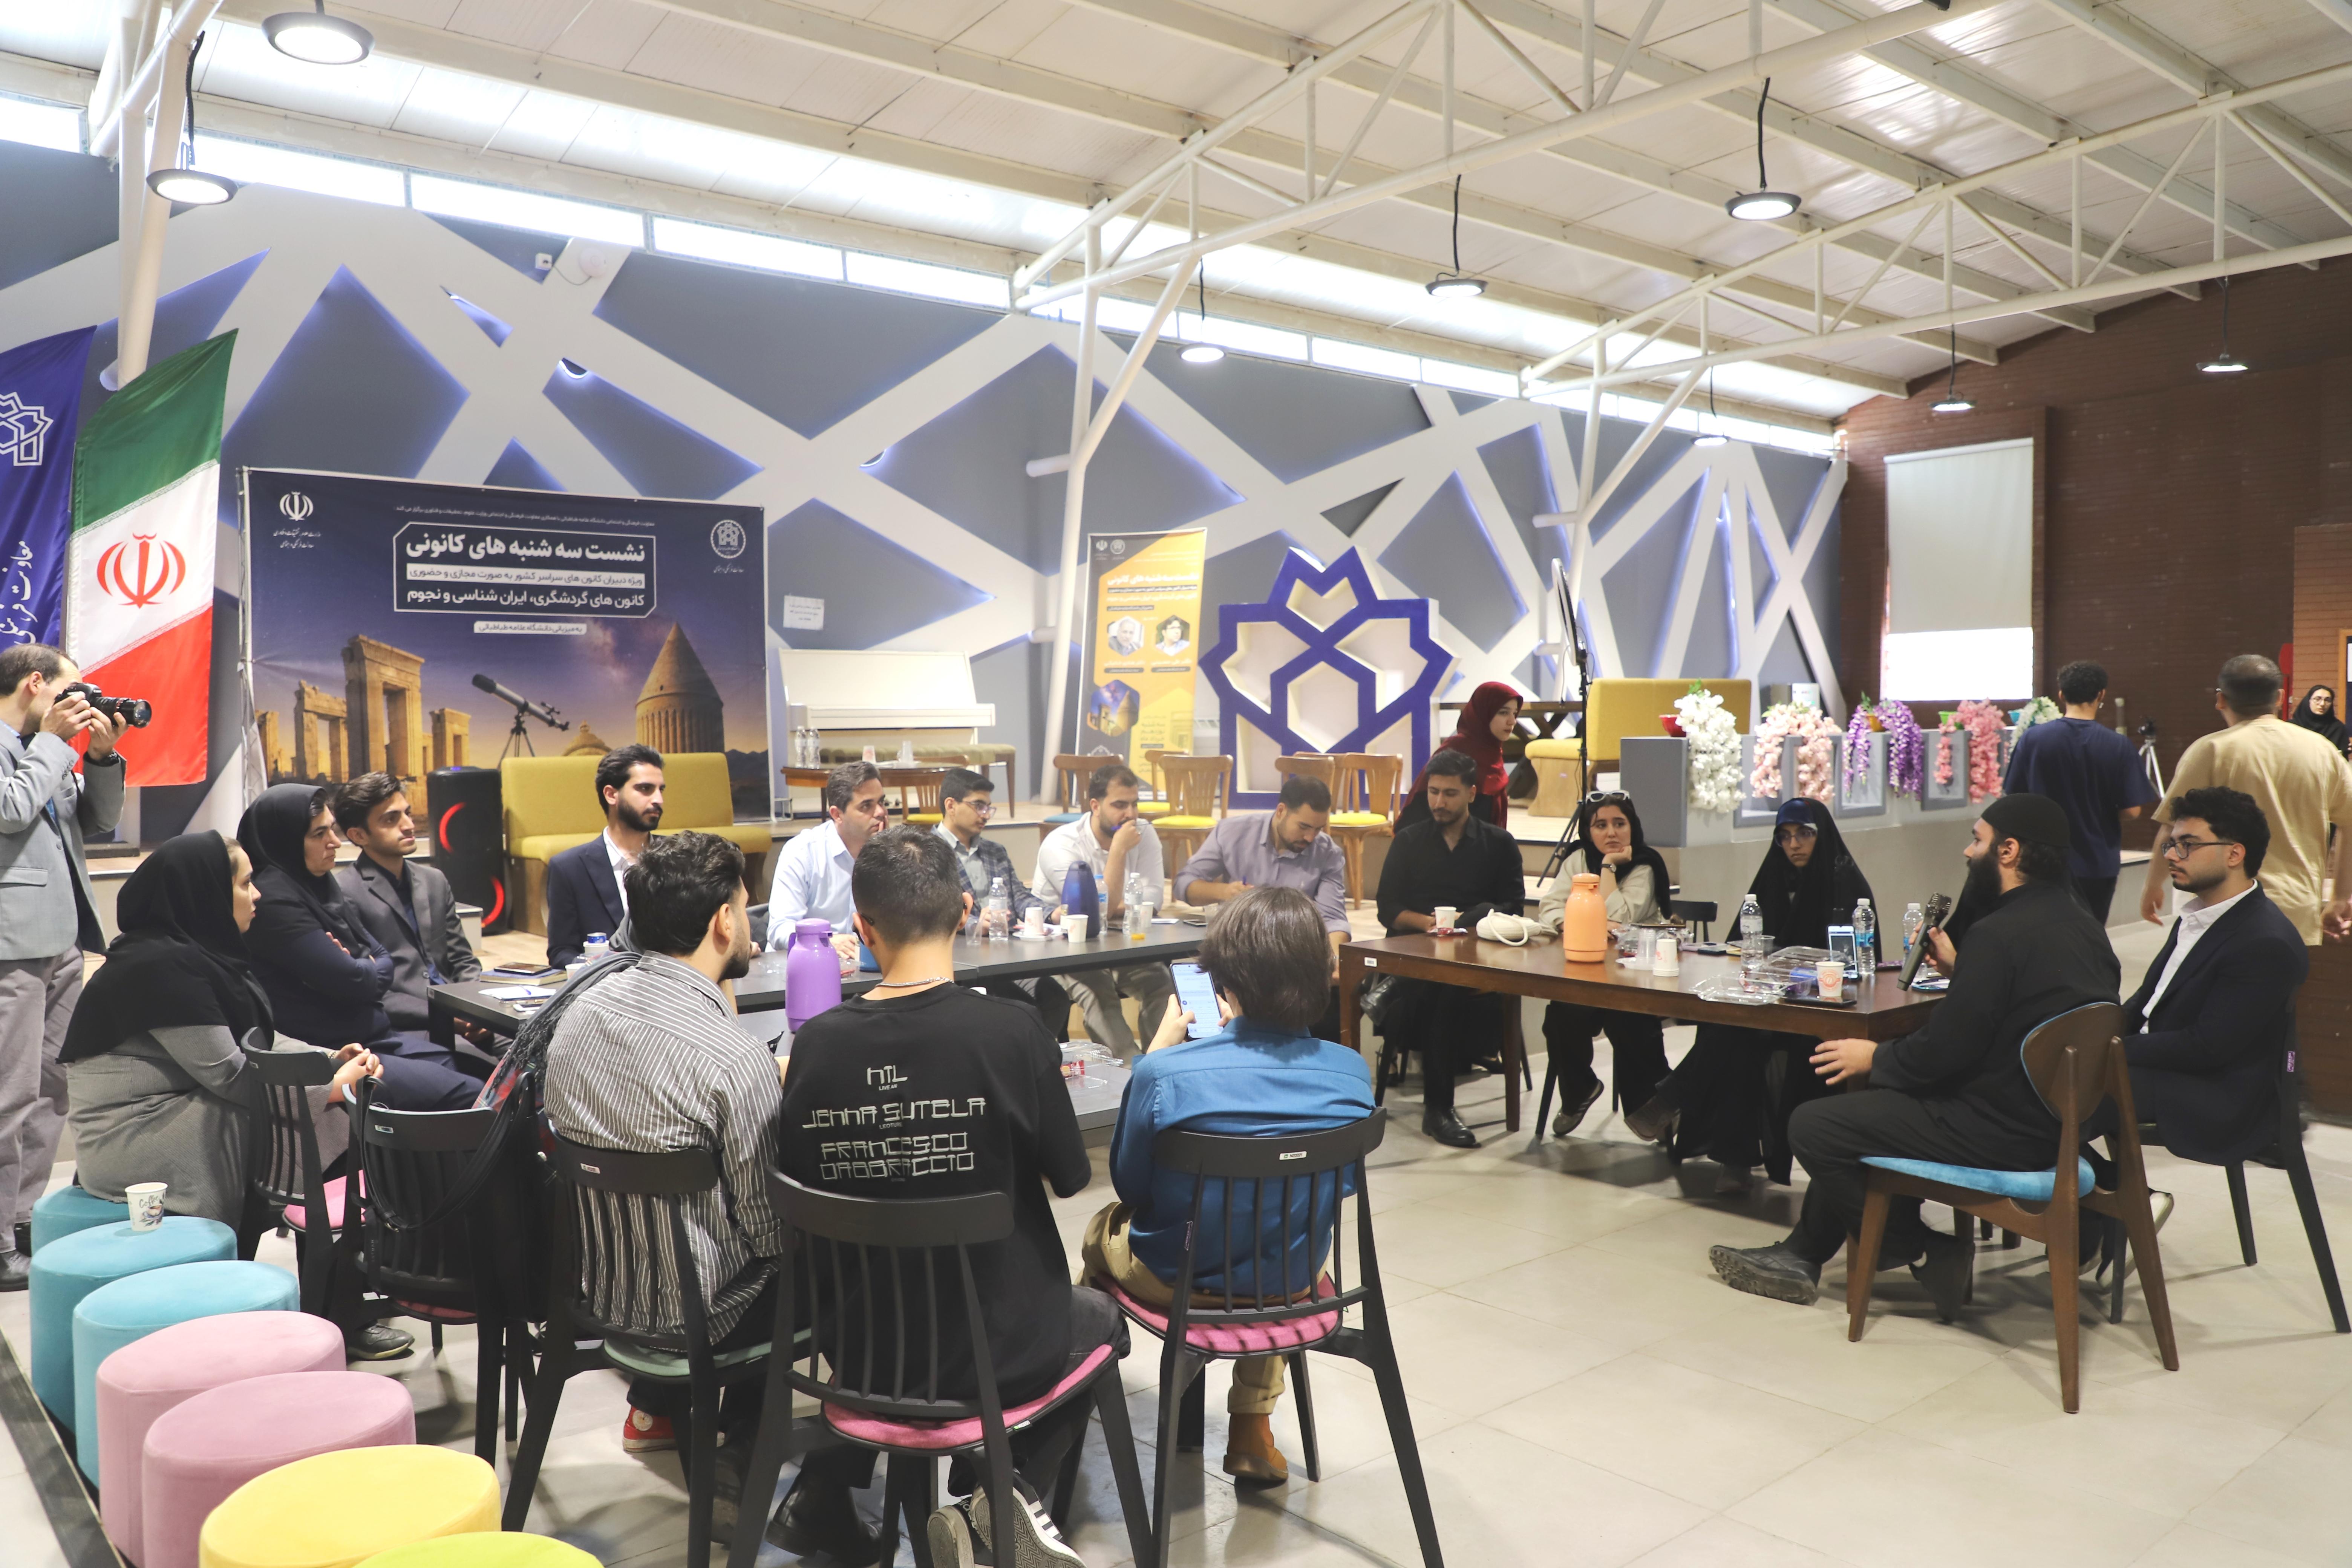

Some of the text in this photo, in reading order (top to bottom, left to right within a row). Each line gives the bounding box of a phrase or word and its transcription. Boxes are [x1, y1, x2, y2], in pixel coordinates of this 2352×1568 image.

[406, 533, 645, 562] نشست سه شنبه های کانونی
[410, 567, 442, 578] حضوری
[450, 569, 476, 579] مجازی
[477, 570, 502, 580] صورت
[514, 572, 536, 582] کشور
[538, 574, 563, 583] سراسر
[565, 574, 580, 583] های
[581, 575, 602, 585] کانون
[603, 576, 626, 585] دبیران
[628, 577, 643, 586] ویژه
[407, 588, 645, 609] کانون های گردشگری، ایران شناسی و نجوم
[882, 1097, 986, 1122] SUTELA
[821, 1132, 968, 1160] FRANCESCO
